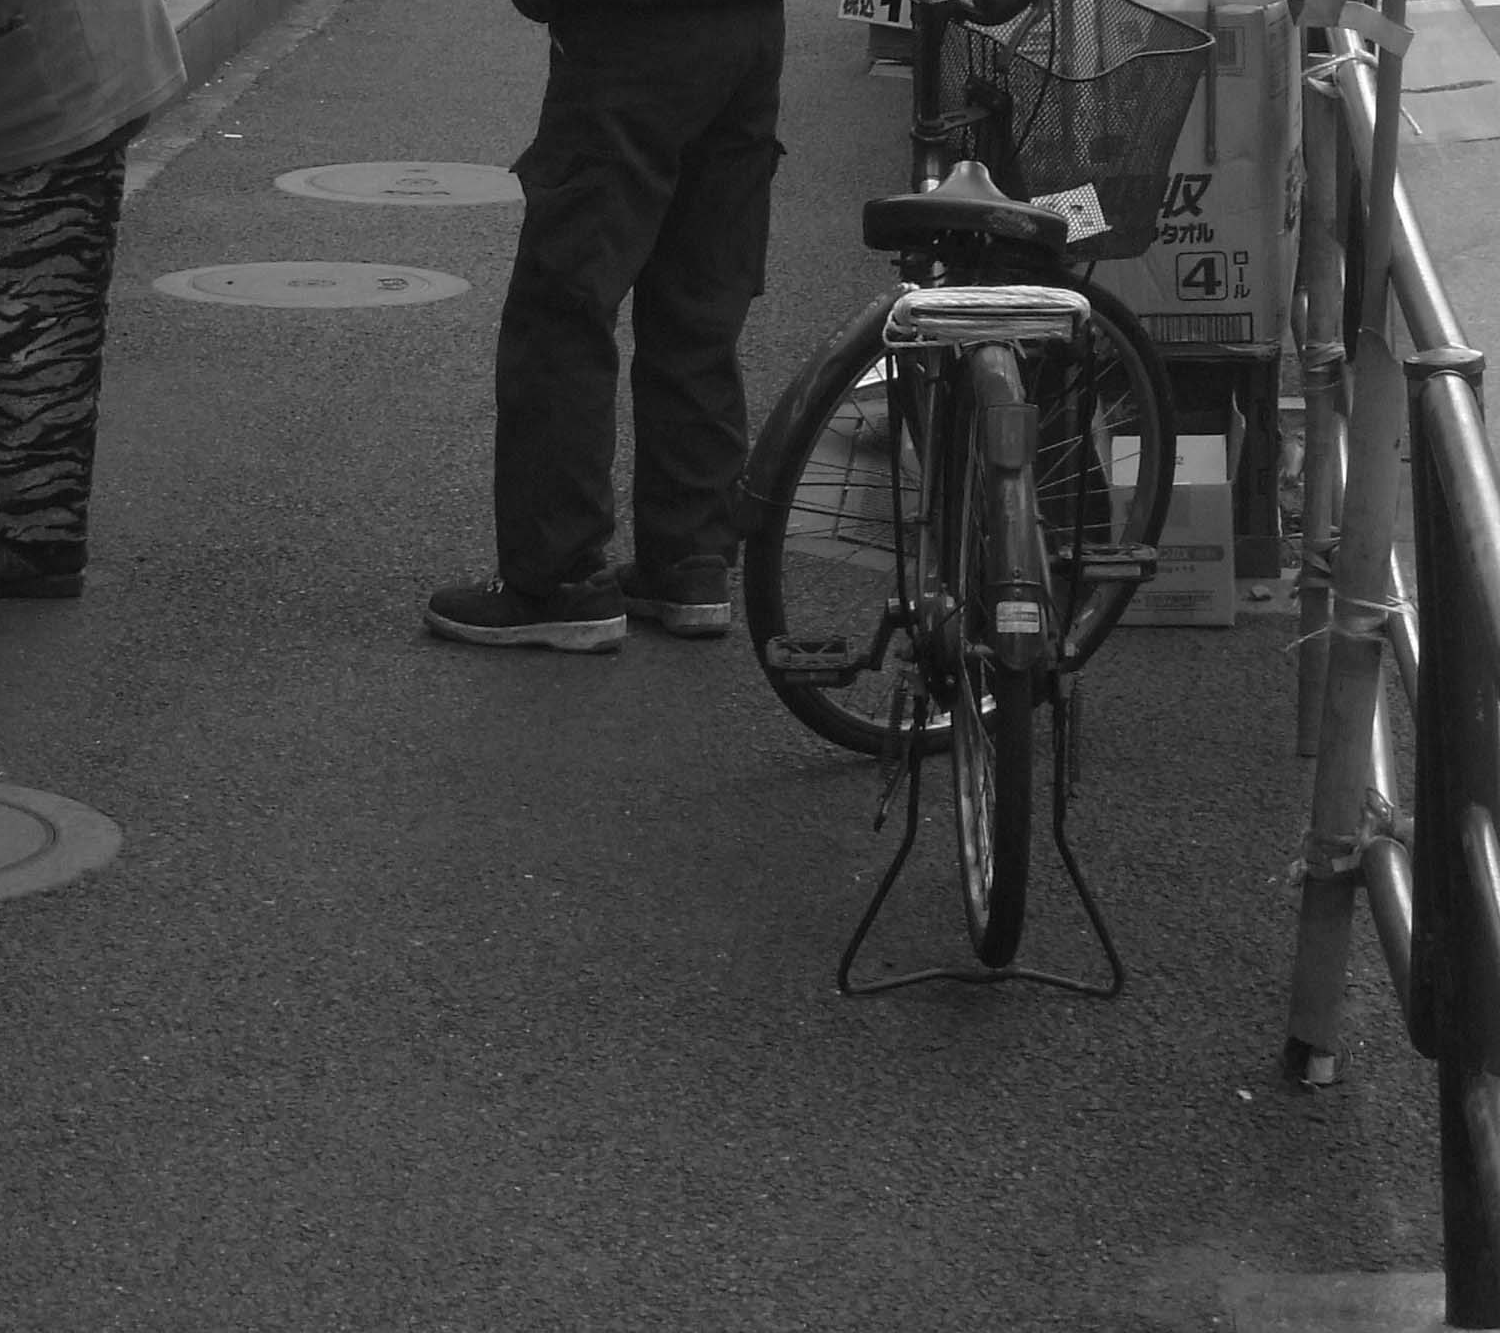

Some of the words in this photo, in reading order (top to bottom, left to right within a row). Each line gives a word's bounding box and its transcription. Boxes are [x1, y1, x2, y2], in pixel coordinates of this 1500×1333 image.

[1182, 257, 1222, 296] 4
[1233, 250, 1251, 299] ロール
